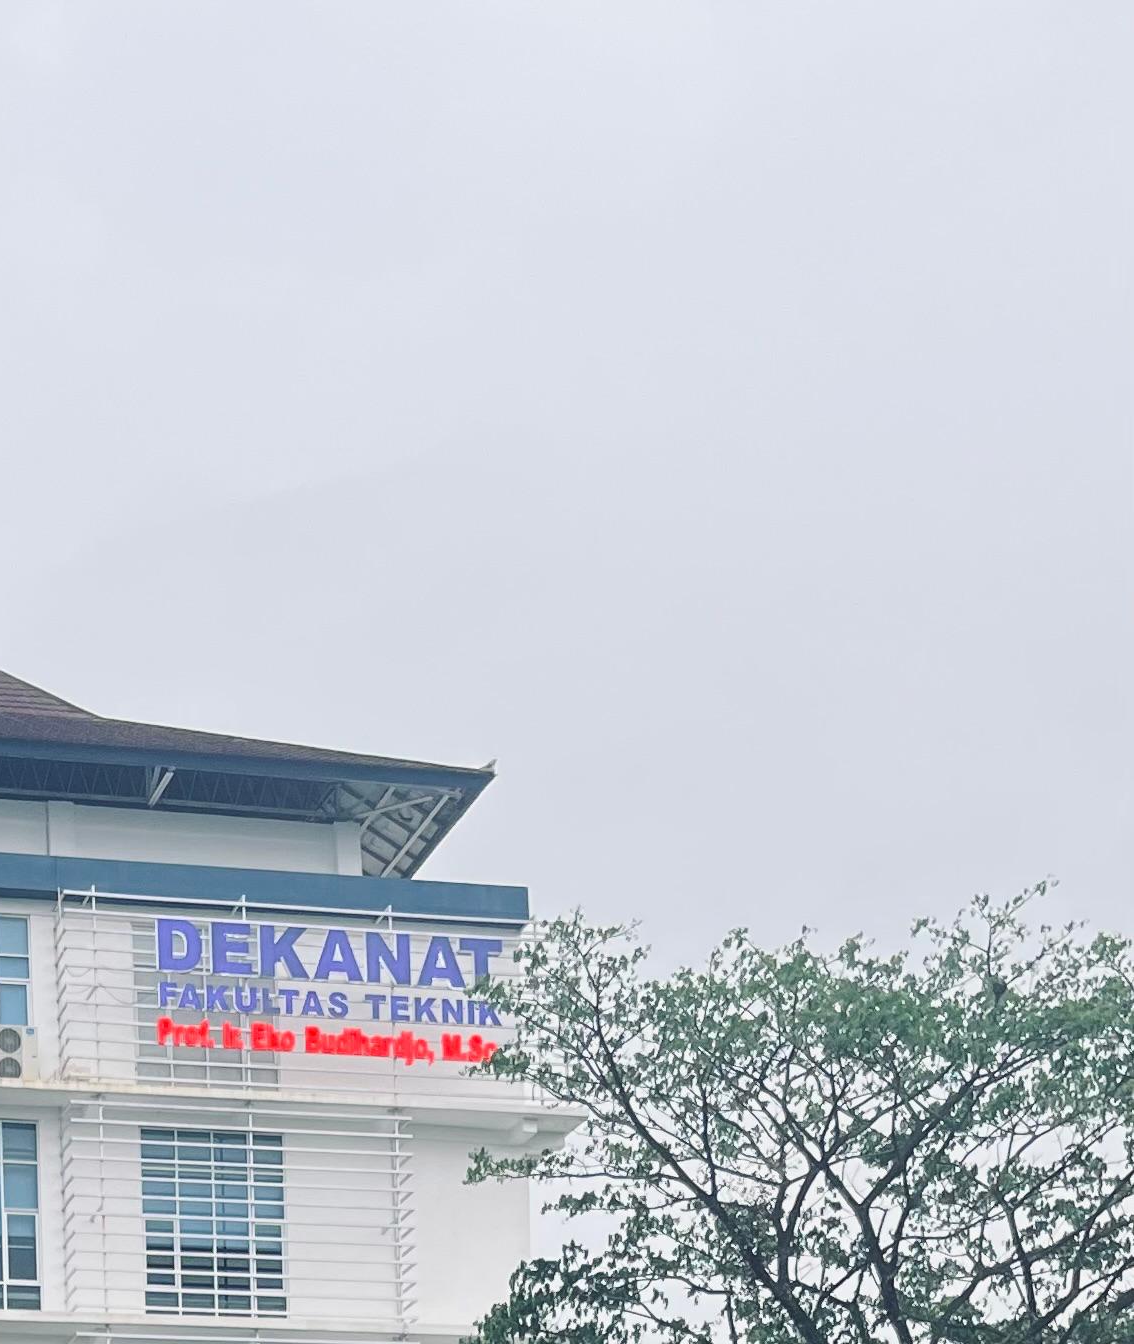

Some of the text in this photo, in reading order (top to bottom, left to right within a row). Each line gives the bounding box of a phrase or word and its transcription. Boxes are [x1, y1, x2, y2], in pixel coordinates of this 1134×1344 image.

[156, 918, 503, 989] DEKANAT
[157, 982, 503, 1026] FAKULTAS TEKNIK
[157, 1016, 215, 1048] Prof.
[250, 1021, 296, 1052] Eko
